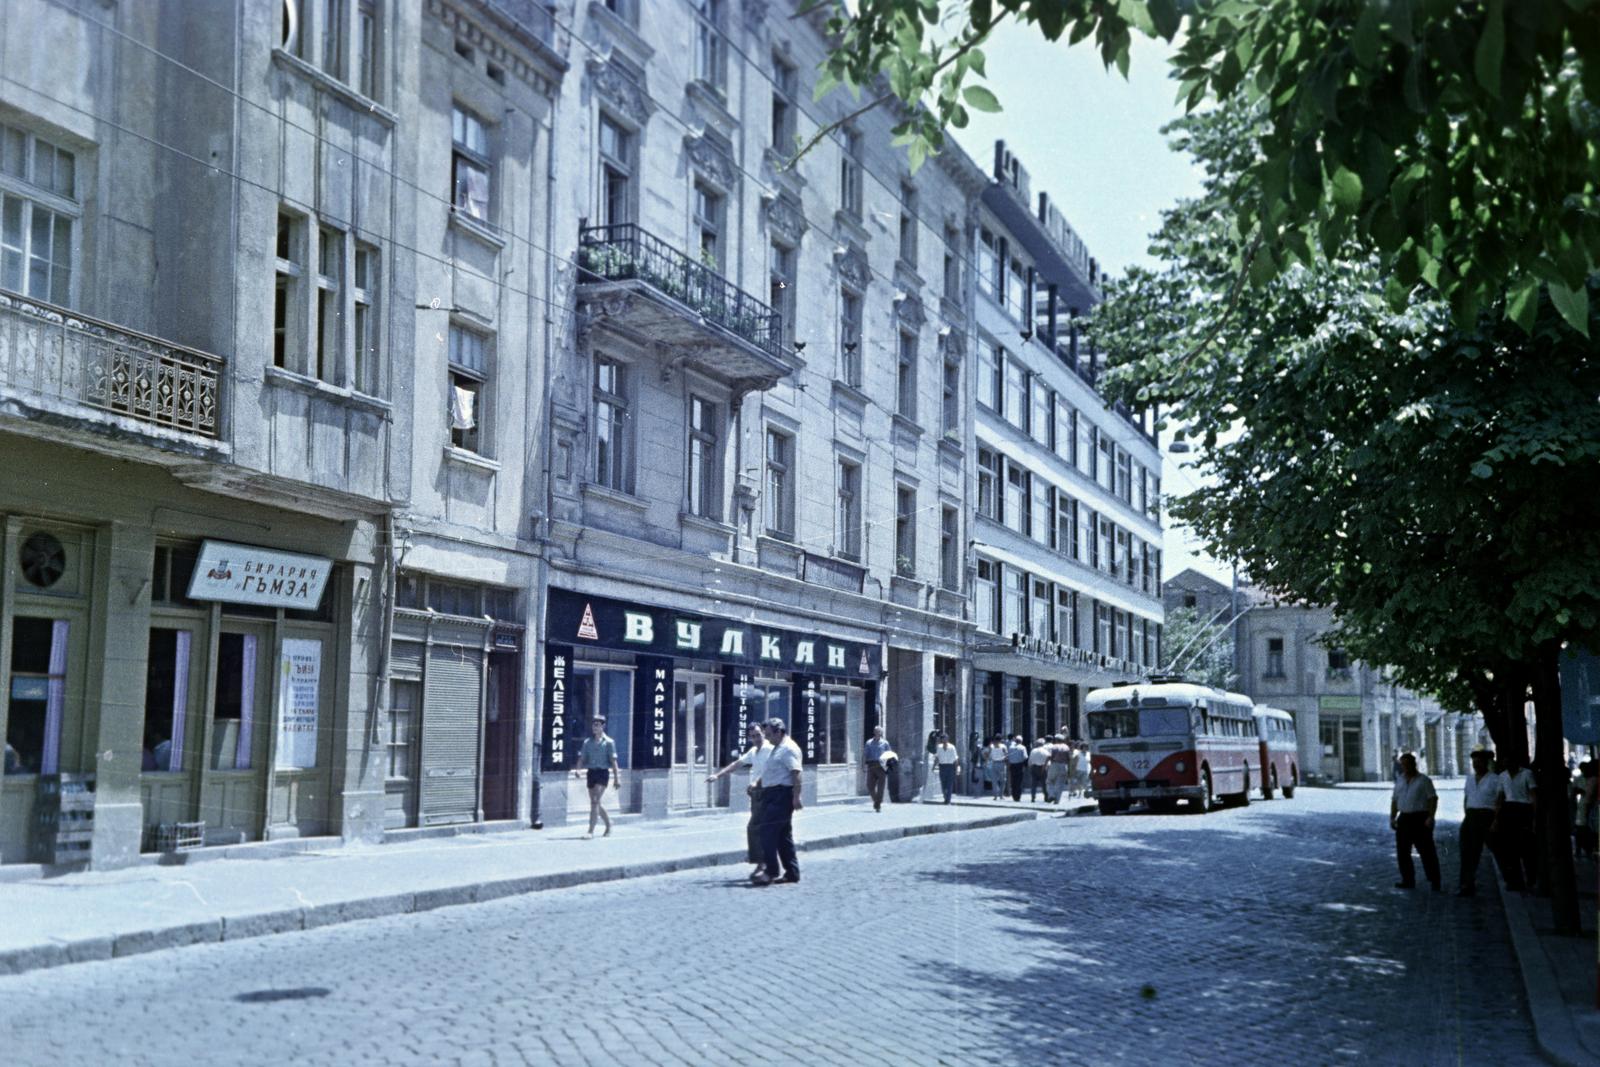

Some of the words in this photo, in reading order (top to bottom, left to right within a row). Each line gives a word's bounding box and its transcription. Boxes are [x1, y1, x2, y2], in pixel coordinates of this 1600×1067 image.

[244, 560, 318, 580] БИРАРИЯ
[624, 610, 846, 670] ВУЛКАН
[551, 655, 566, 764] ЖЕЛЕЗАРИЯ
[653, 668, 666, 757] МАРКУЧИ
[738, 674, 748, 760] ИНСТРУМЕНТ
